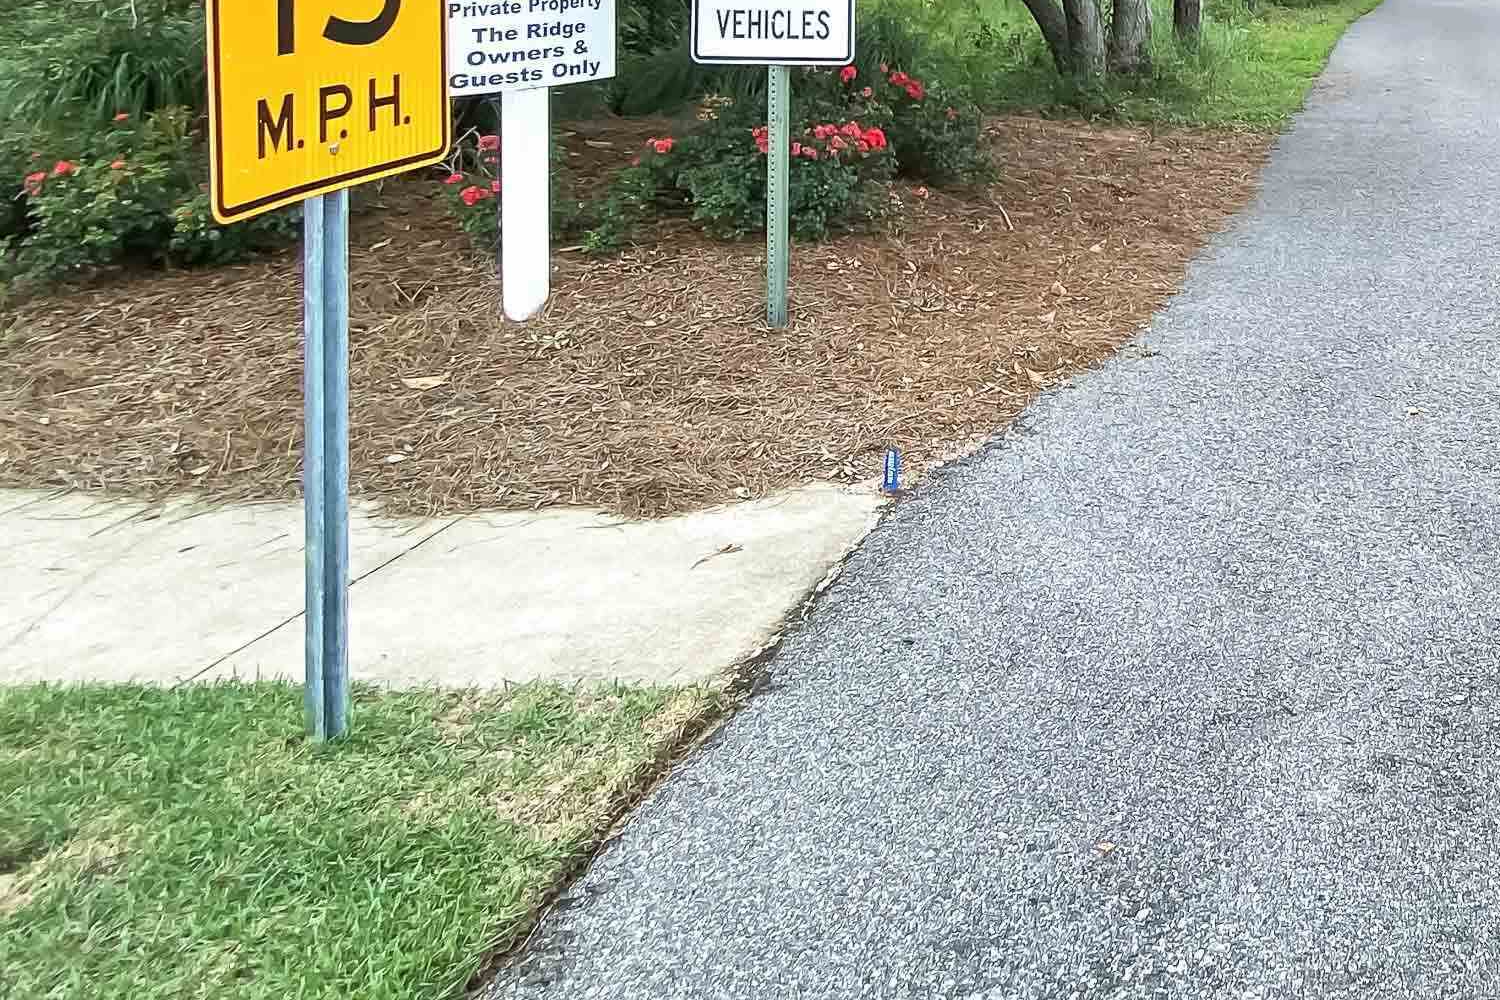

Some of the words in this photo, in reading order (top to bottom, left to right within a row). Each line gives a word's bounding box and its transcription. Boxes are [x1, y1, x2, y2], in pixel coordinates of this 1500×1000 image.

[448, 1, 520, 18] Private
[471, 26, 518, 44] The
[527, 19, 586, 43] Ridge
[716, 9, 831, 42] VEHICLES
[467, 46, 564, 66] Owners
[573, 40, 589, 56] &
[449, 67, 543, 89] Guests
[551, 58, 602, 82] Only
[257, 74, 411, 160] M.P.H.
